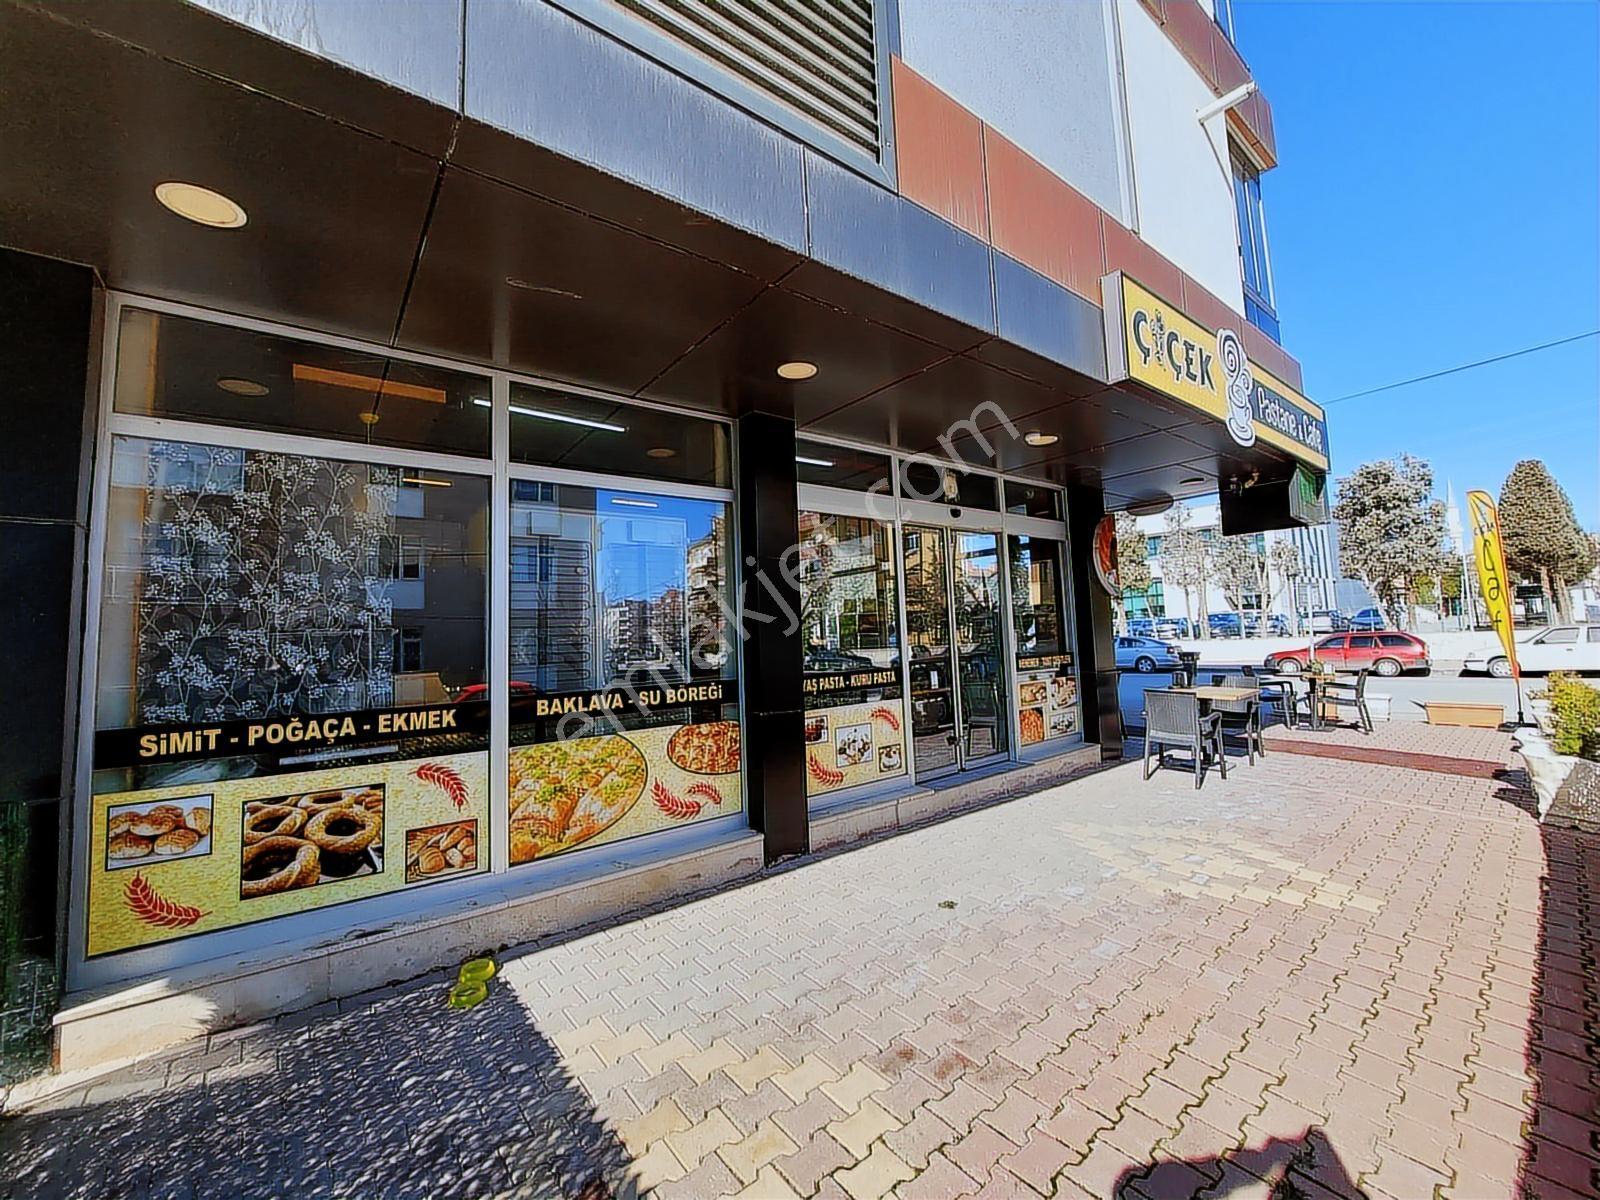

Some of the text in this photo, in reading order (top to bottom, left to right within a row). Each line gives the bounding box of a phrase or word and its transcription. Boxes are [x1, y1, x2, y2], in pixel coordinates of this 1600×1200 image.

[819, 675, 845, 691] PASTA
[873, 671, 897, 684] PASTA
[536, 693, 624, 716] BAKLAVA
[639, 689, 661, 706] SU
[248, 717, 356, 746] POĞAÇA
[378, 708, 457, 734] EKMEK
